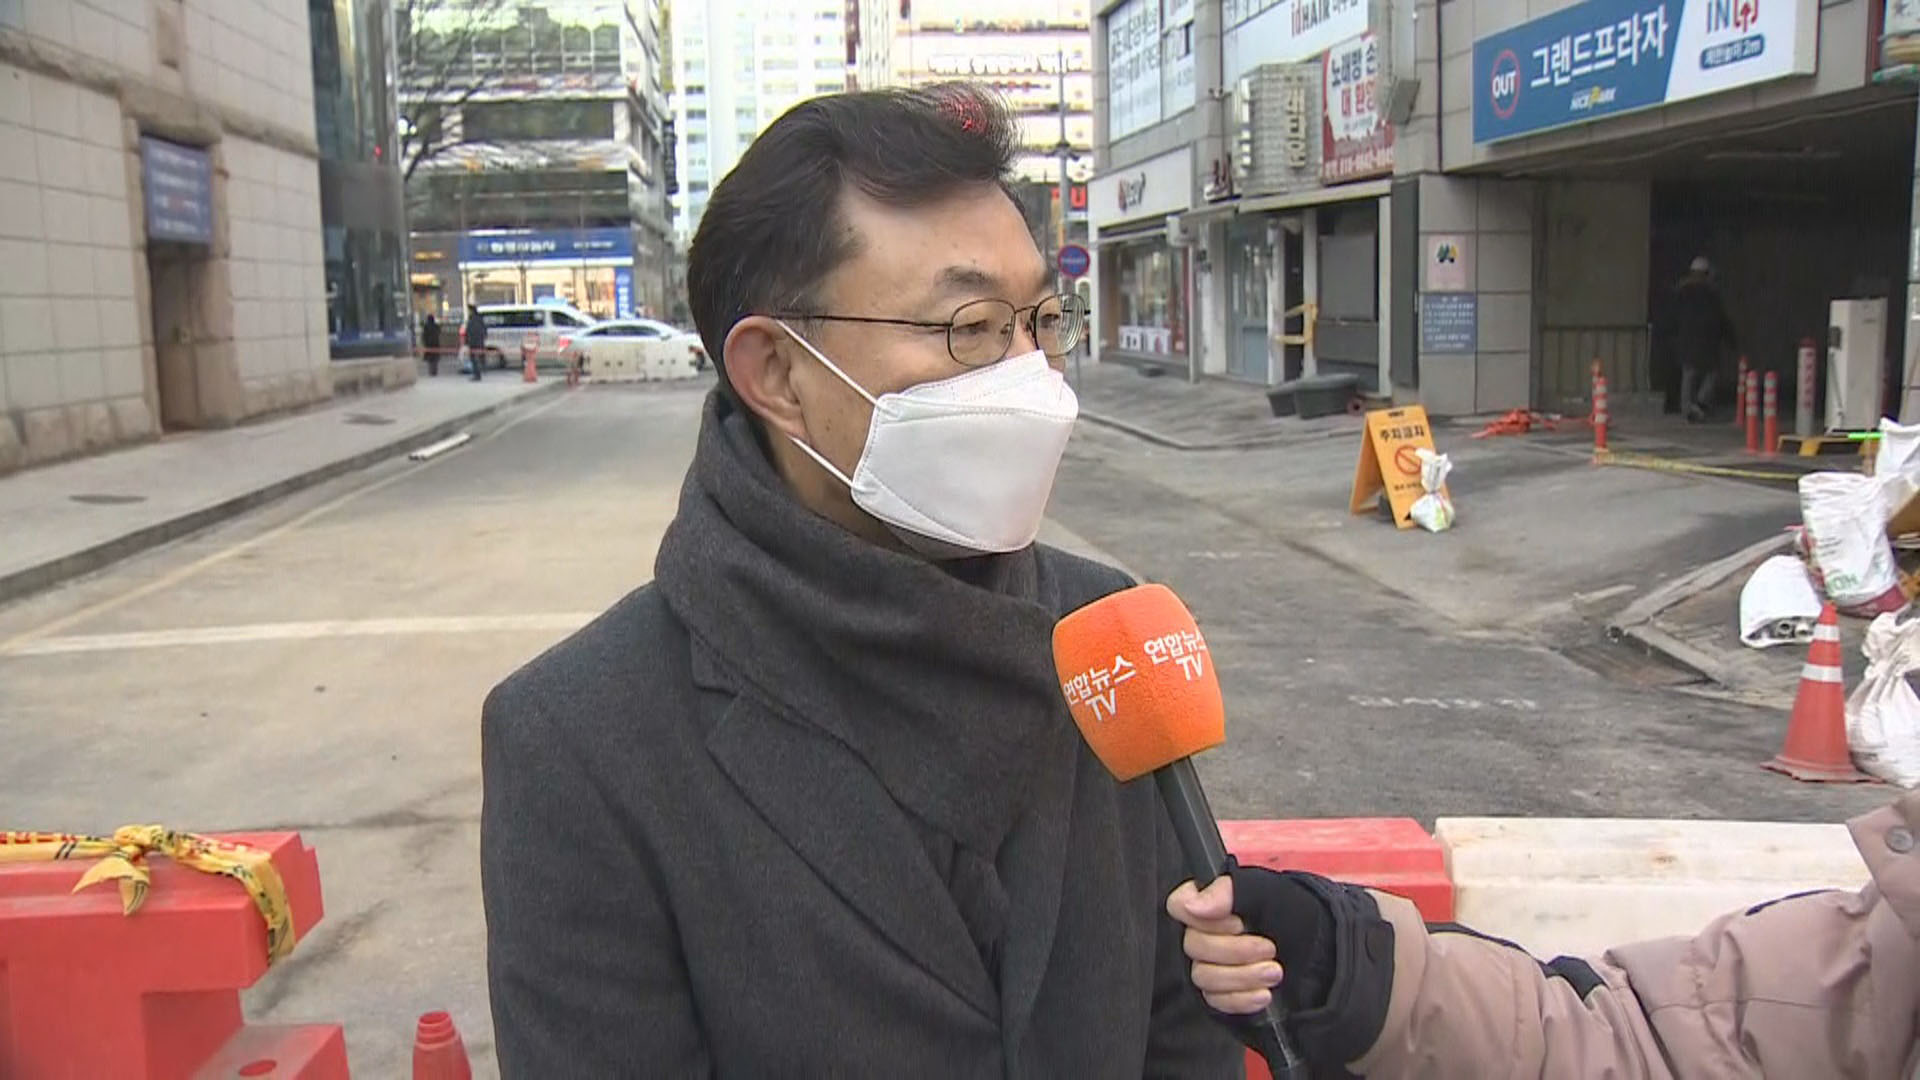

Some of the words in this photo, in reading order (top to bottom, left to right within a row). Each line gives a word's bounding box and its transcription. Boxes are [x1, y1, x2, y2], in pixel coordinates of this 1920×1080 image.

[1366, 42, 1378, 76] 손
[1531, 3, 1669, 88] 그랜드프라자
[1492, 70, 1517, 100] OUT
[1063, 655, 1136, 705] 연합뉴스
[1176, 653, 1203, 681] TV
[1085, 687, 1117, 721] TV
